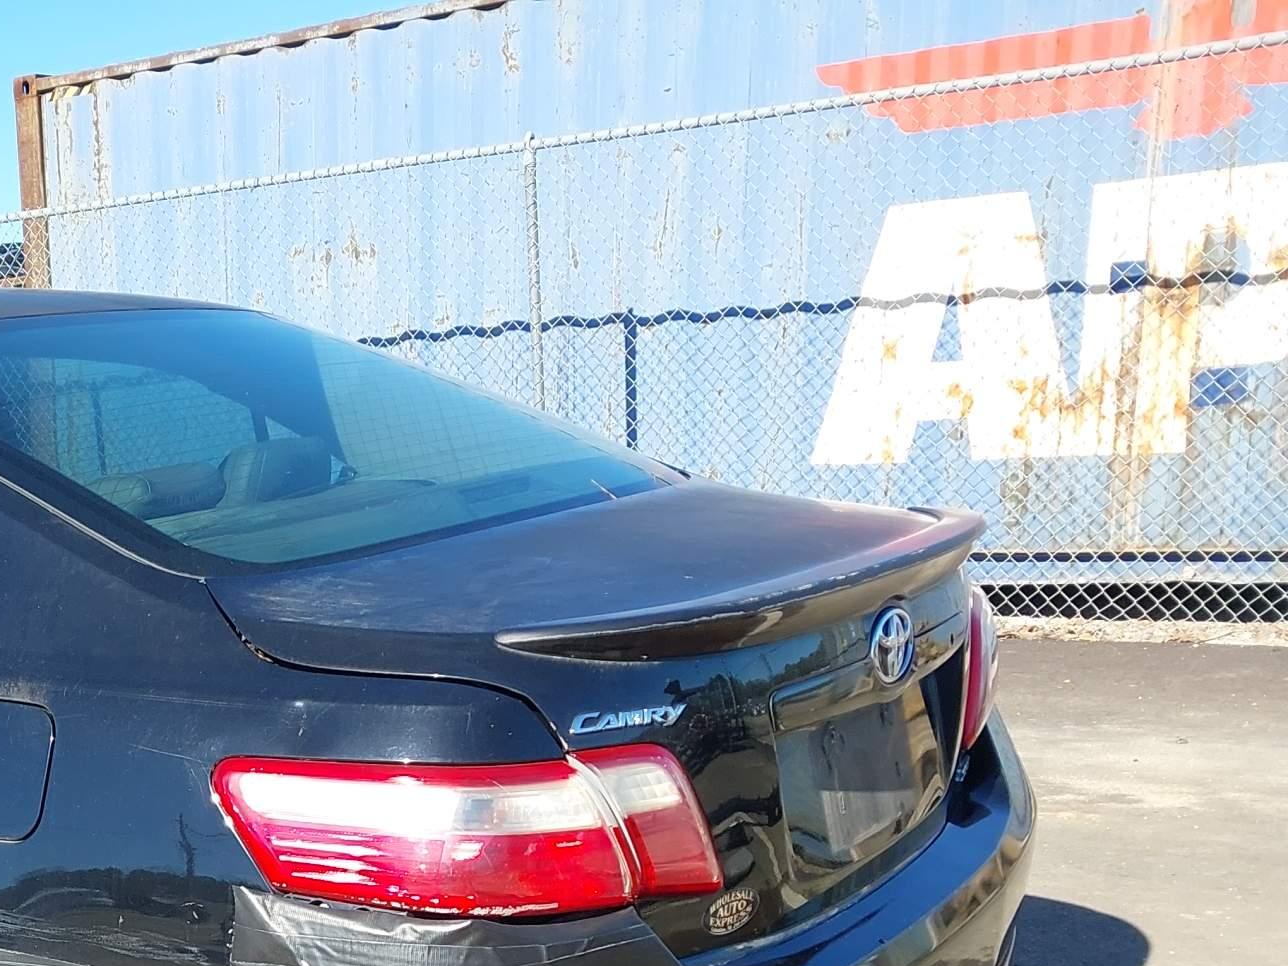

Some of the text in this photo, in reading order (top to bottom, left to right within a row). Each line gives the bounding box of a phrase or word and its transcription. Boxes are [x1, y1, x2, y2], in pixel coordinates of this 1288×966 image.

[569, 703, 688, 734] CAMRY
[709, 889, 754, 915] WHOLESALE
[716, 899, 748, 918] AUTO
